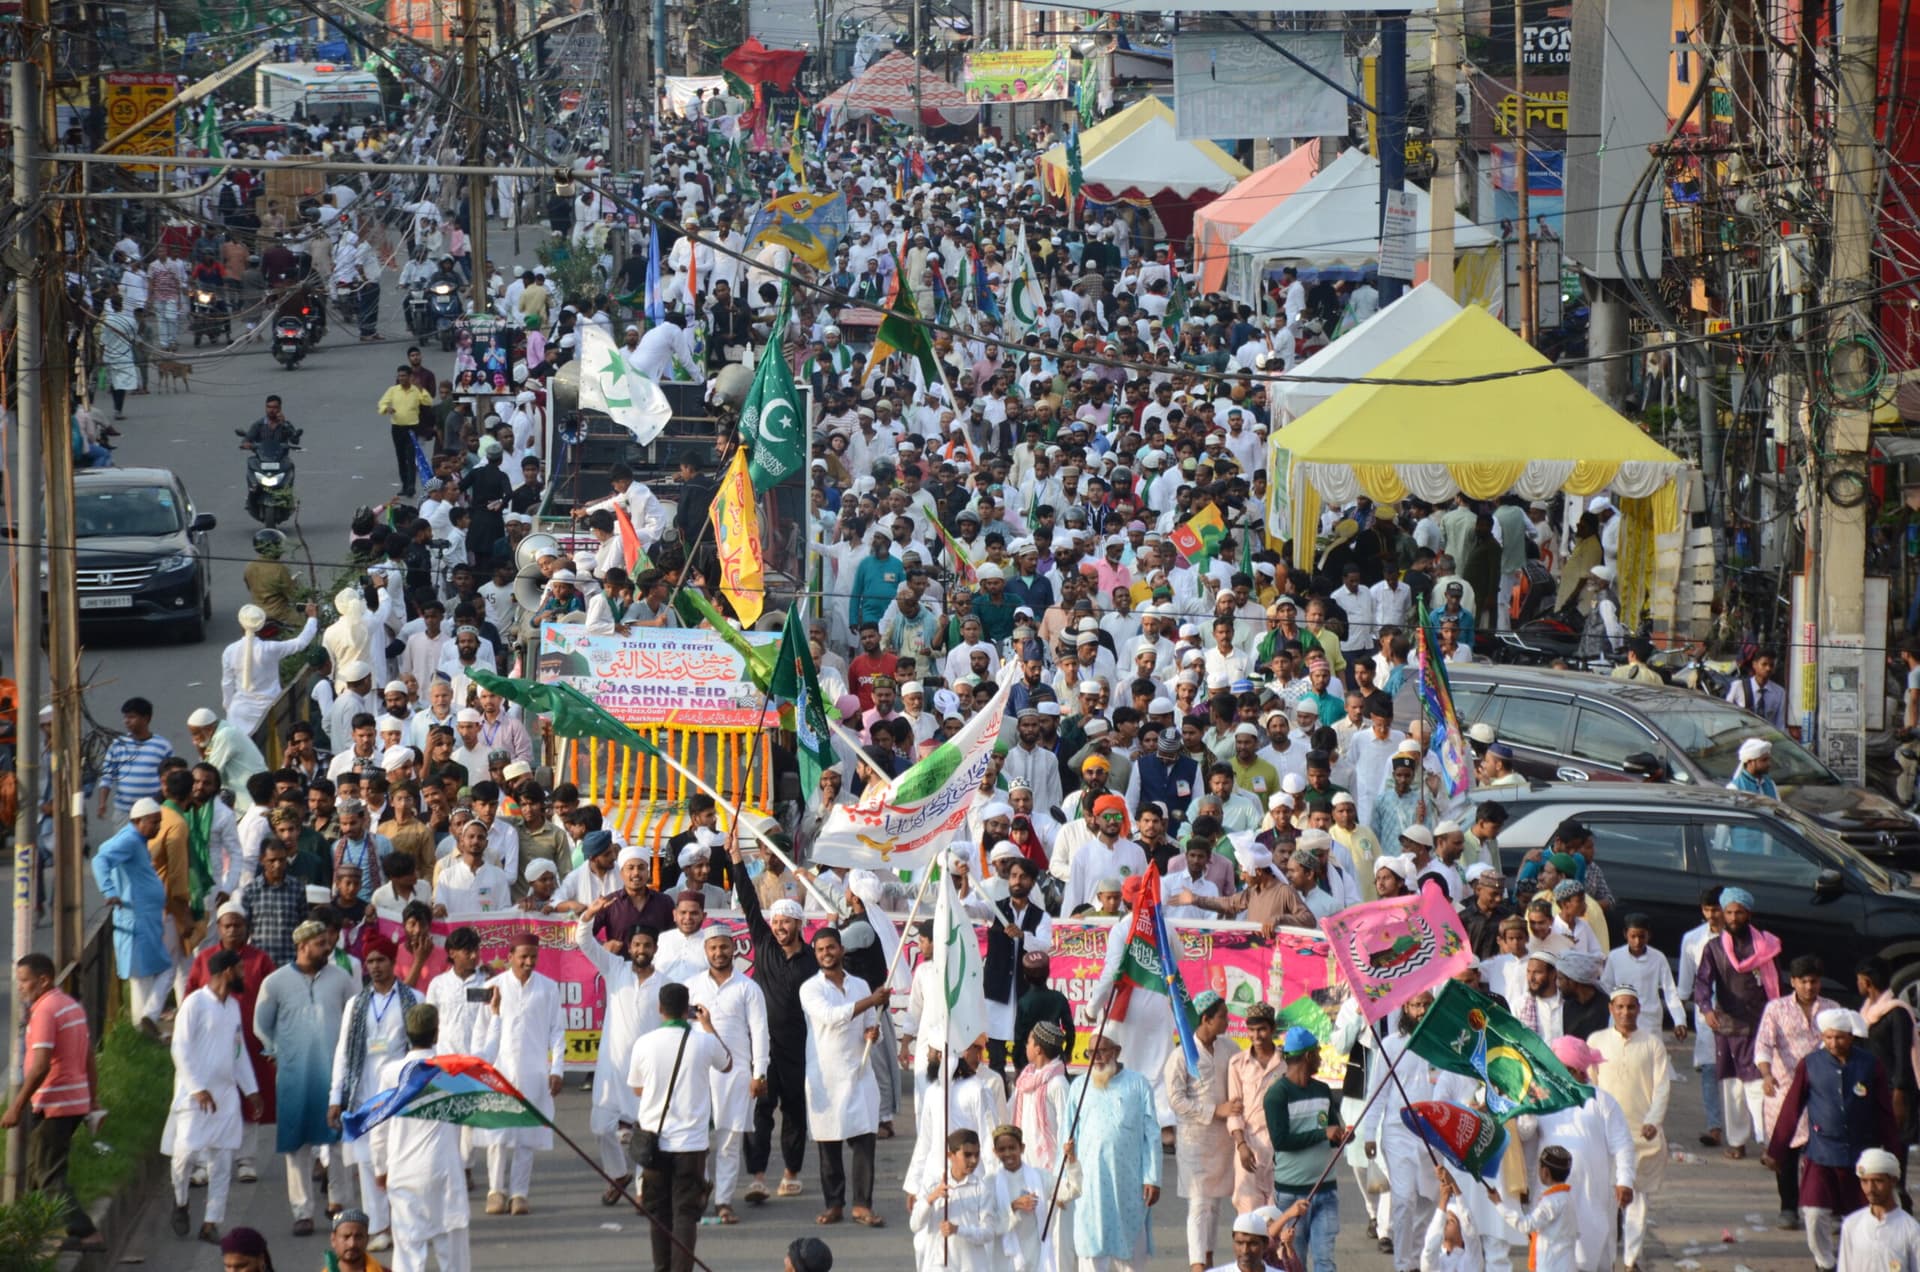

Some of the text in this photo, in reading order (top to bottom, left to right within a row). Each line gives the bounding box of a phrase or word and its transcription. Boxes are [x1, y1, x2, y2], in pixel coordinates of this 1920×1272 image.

[622, 641, 656, 649] 1500
[605, 684, 727, 697] JASHN-E-EID
[594, 695, 736, 709] MILADUN NABI
